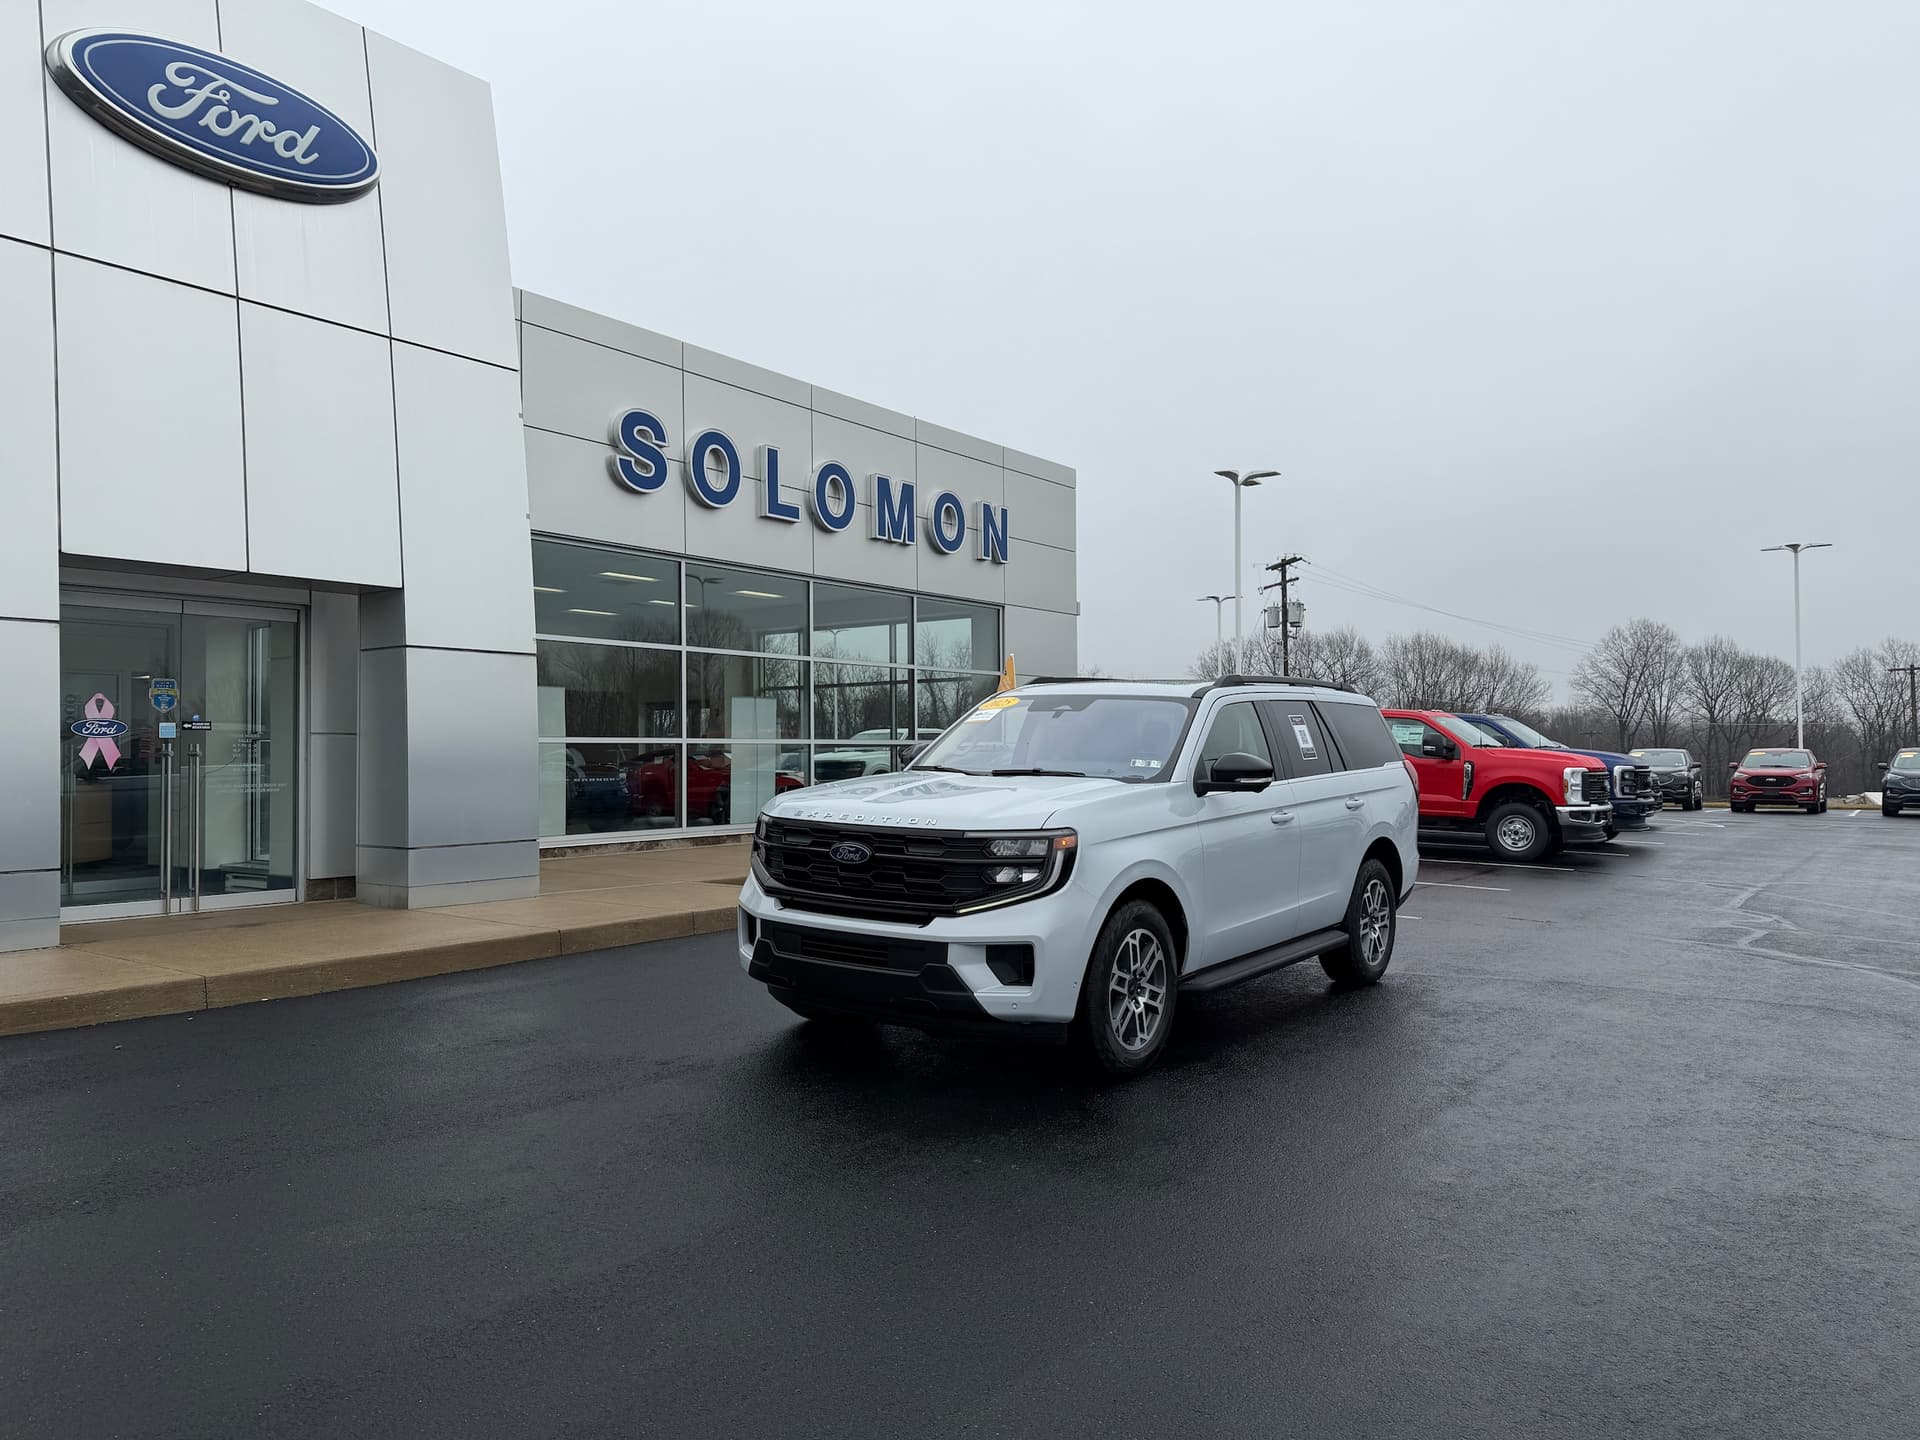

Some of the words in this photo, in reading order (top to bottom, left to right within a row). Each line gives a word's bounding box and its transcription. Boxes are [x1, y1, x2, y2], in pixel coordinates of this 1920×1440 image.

[147, 61, 320, 165] Ford
[611, 407, 1009, 564] SOLOMON
[82, 720, 118, 735] Ford
[794, 810, 938, 826] EXPEDITION
[836, 846, 862, 862] Ford
